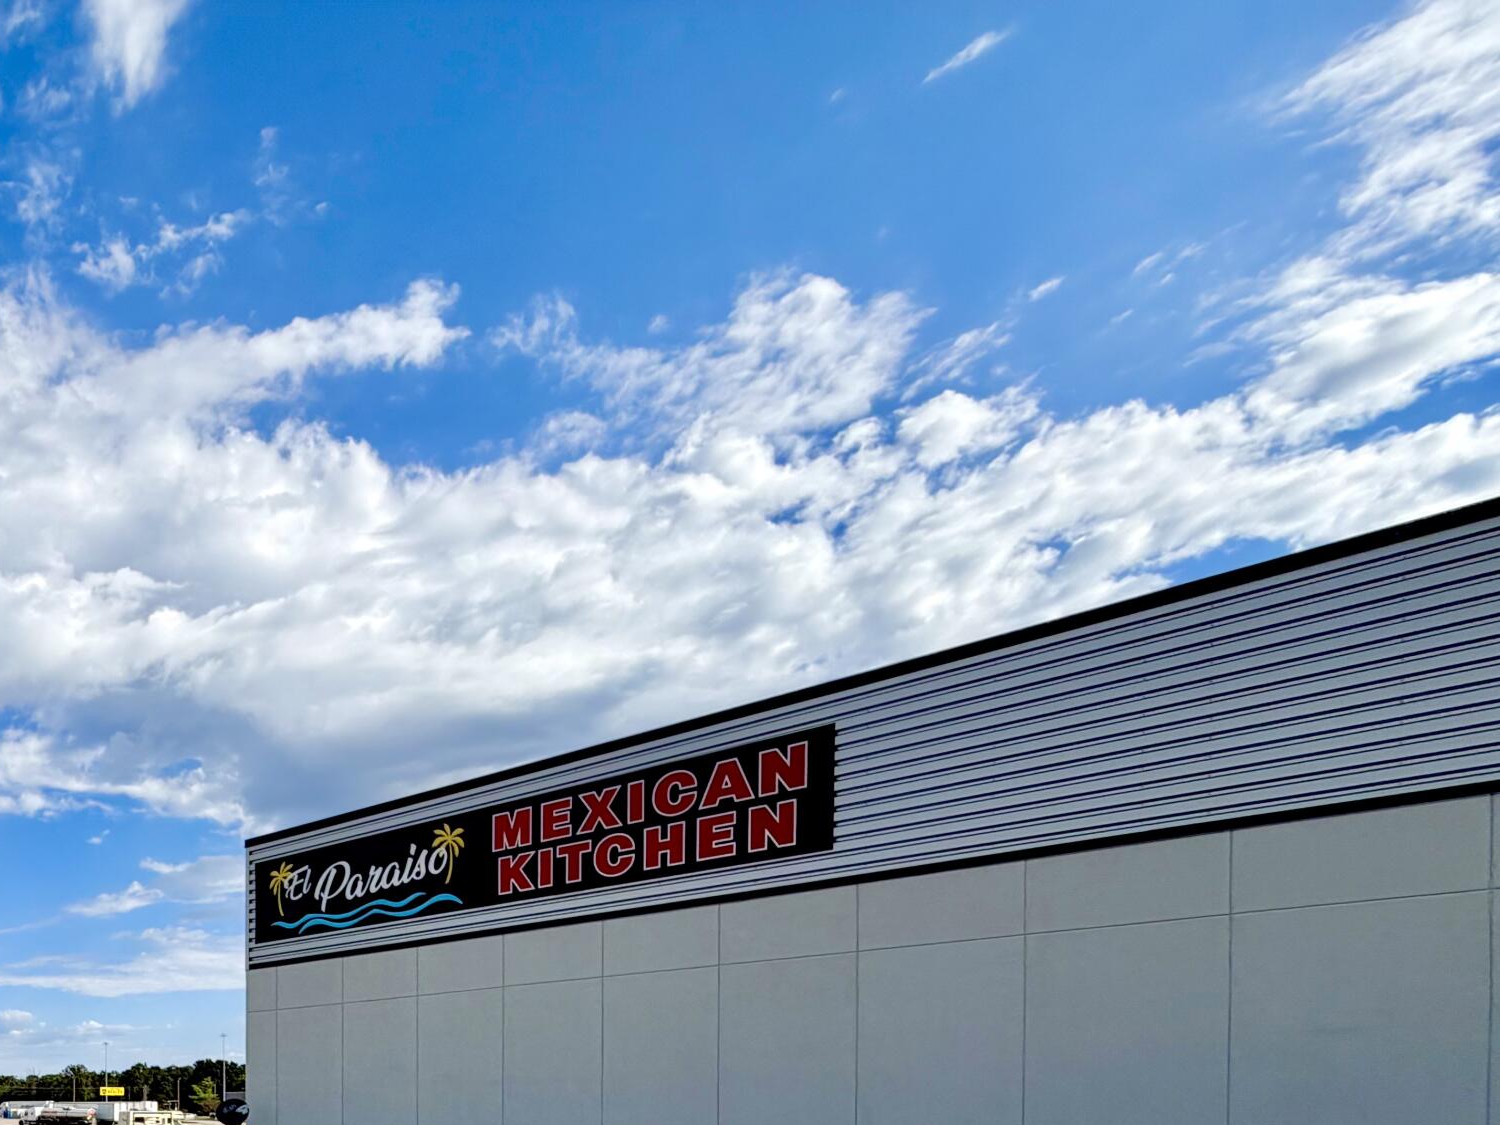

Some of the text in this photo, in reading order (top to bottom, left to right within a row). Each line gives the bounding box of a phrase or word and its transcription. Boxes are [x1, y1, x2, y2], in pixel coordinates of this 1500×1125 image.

[492, 741, 808, 853] MEXICAN
[285, 843, 448, 912] El Paraiso
[498, 798, 797, 896] KITCHEN
